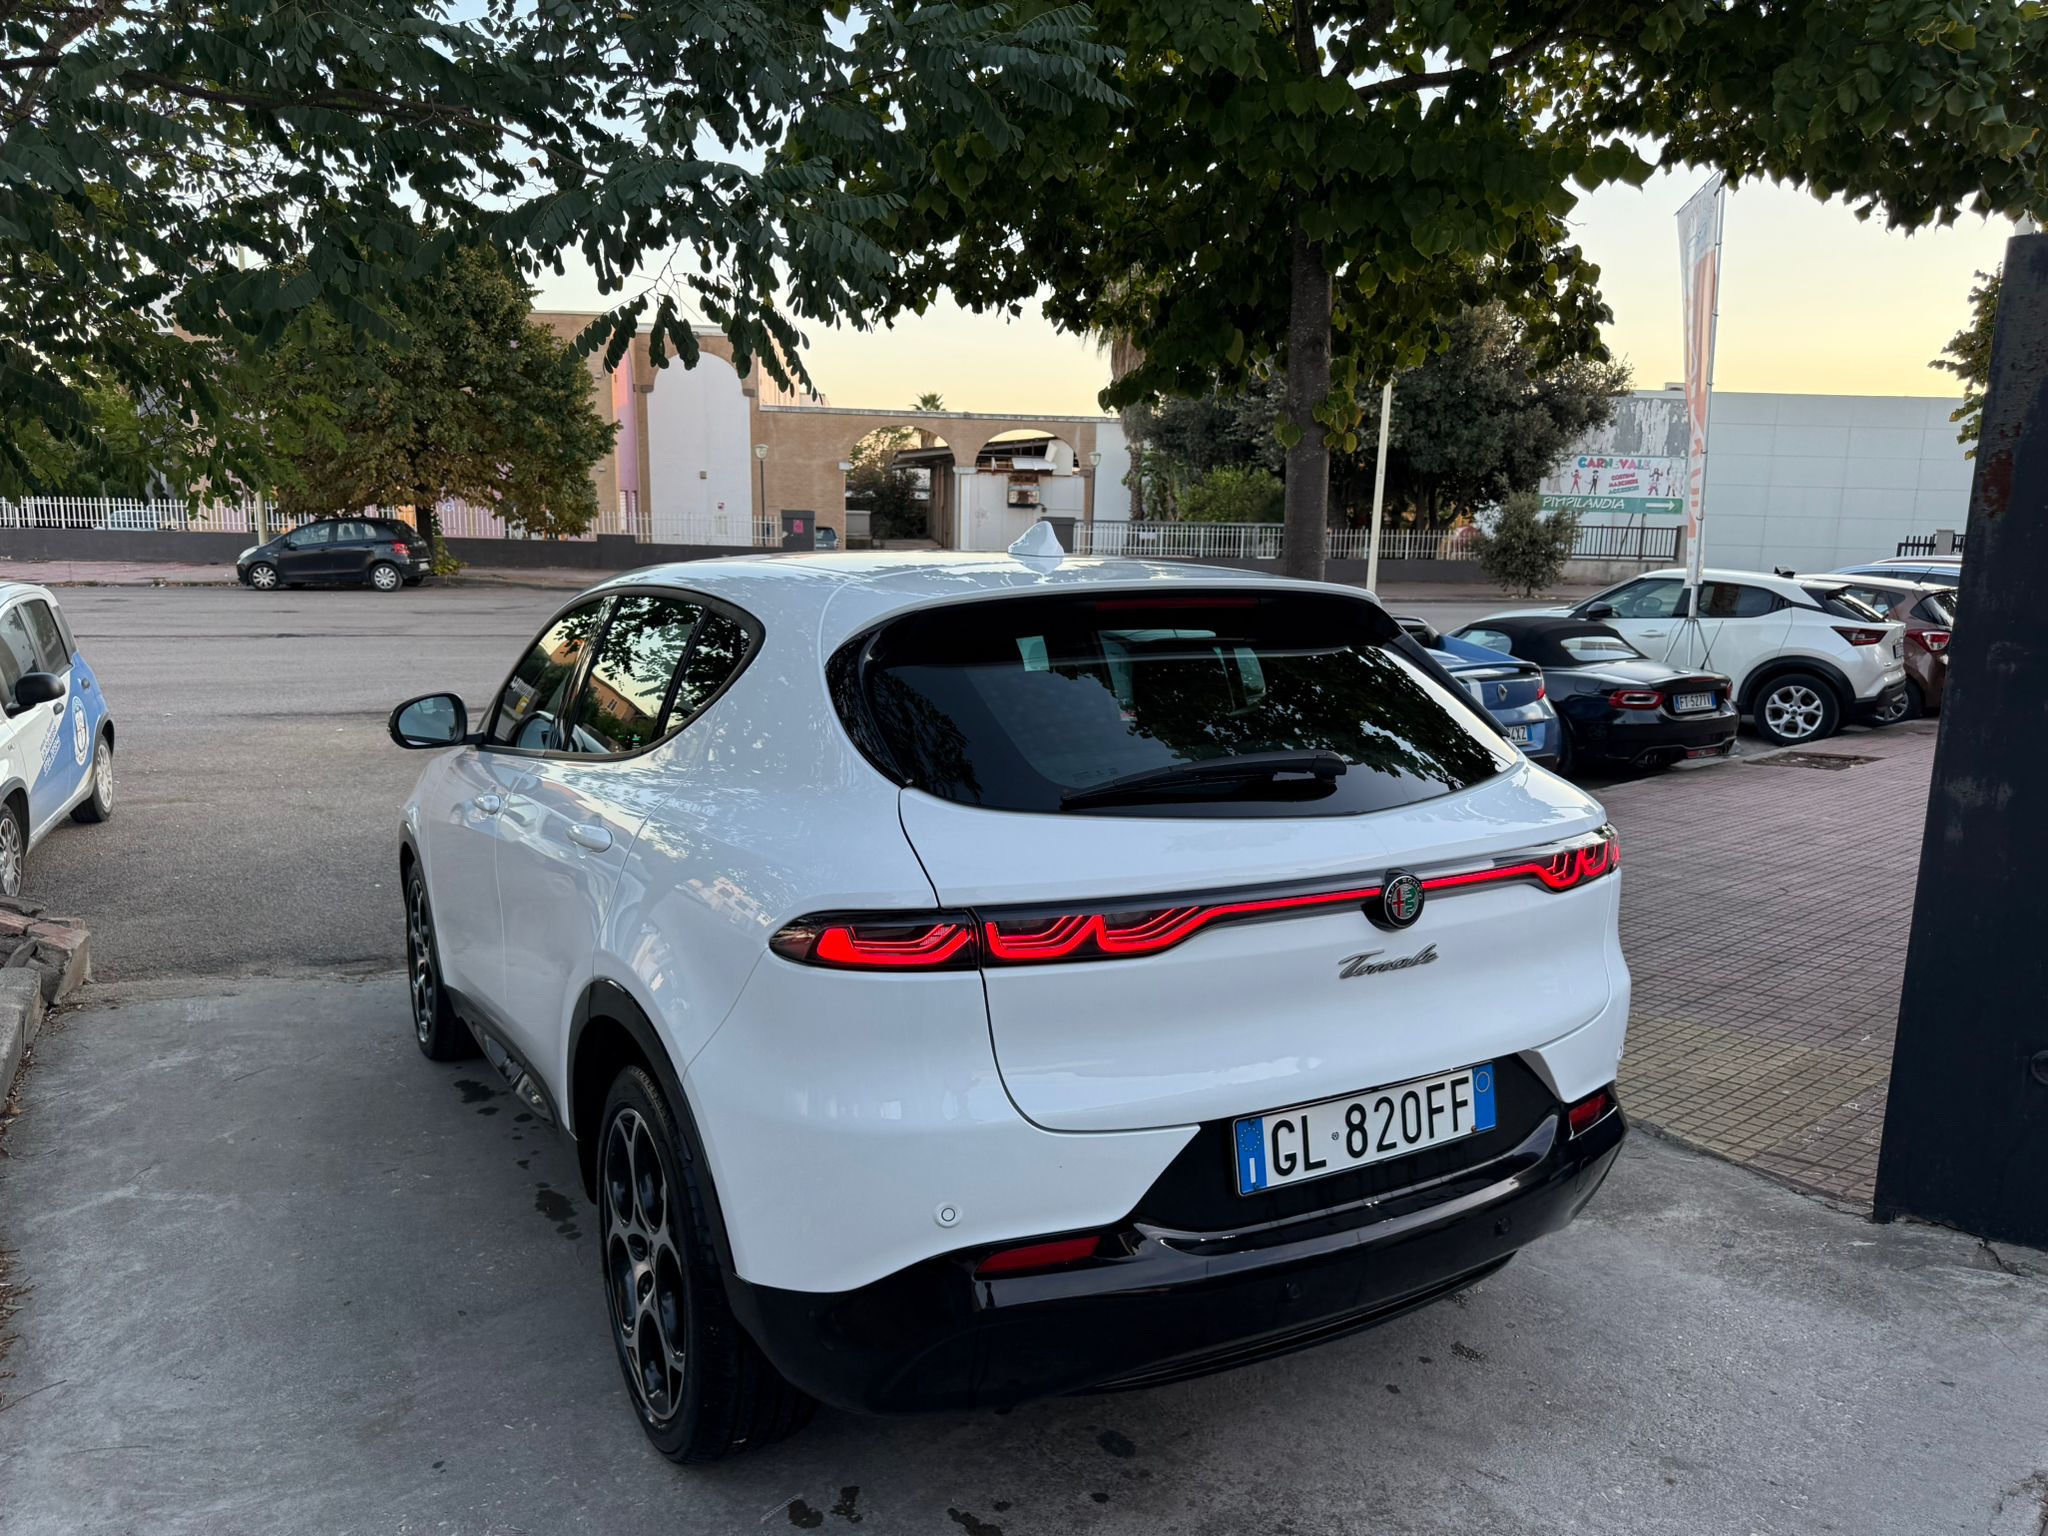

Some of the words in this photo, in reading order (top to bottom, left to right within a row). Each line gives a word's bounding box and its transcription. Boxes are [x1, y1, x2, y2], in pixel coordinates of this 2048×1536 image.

[1578, 457, 1650, 470] CARNEVALE
[1542, 496, 1625, 509] PIMPILANDIA
[1507, 727, 1527, 740] 4XZ
[1271, 1115, 1327, 1177] GL
[1345, 1076, 1469, 1159] 820FF
